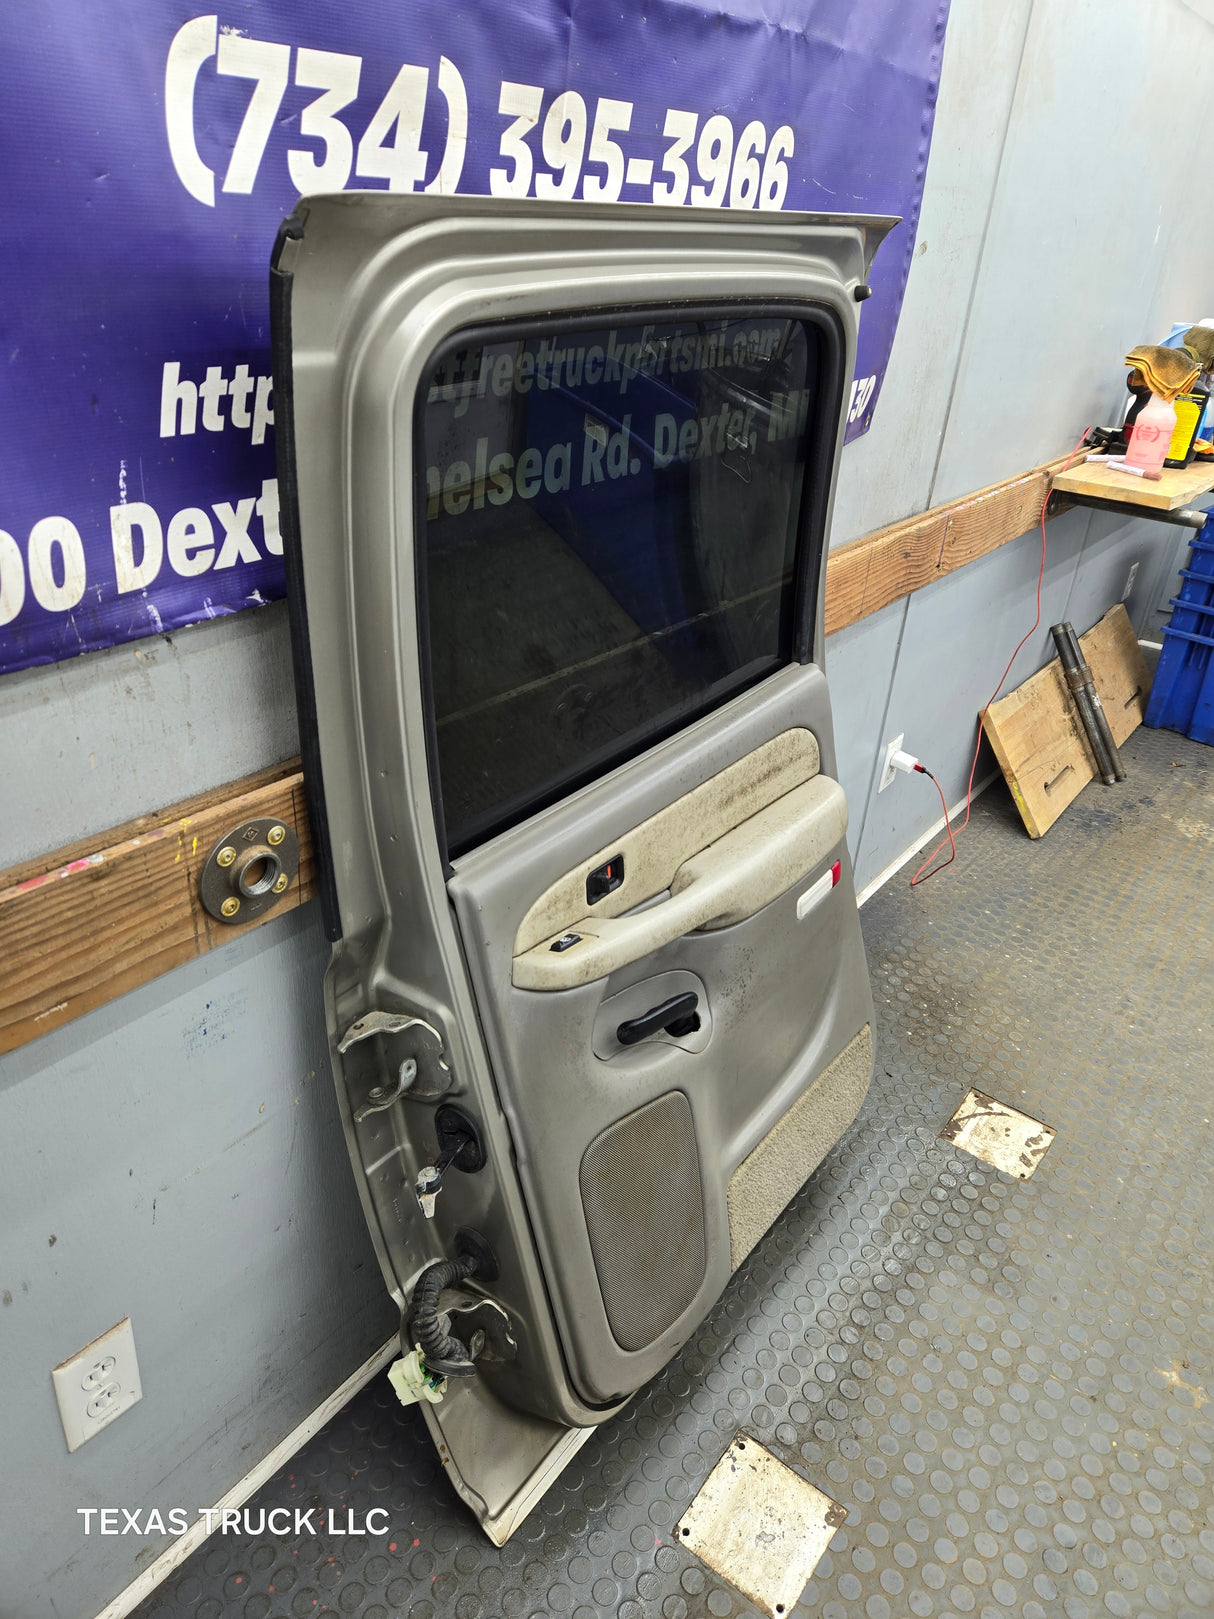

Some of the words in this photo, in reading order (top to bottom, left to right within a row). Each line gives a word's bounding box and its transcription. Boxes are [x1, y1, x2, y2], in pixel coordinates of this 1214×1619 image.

[165, 15, 467, 208] (734)
[490, 81, 795, 210] 395-3966
[581, 413, 642, 486] Rd.
[653, 402, 758, 470] Dexter,
